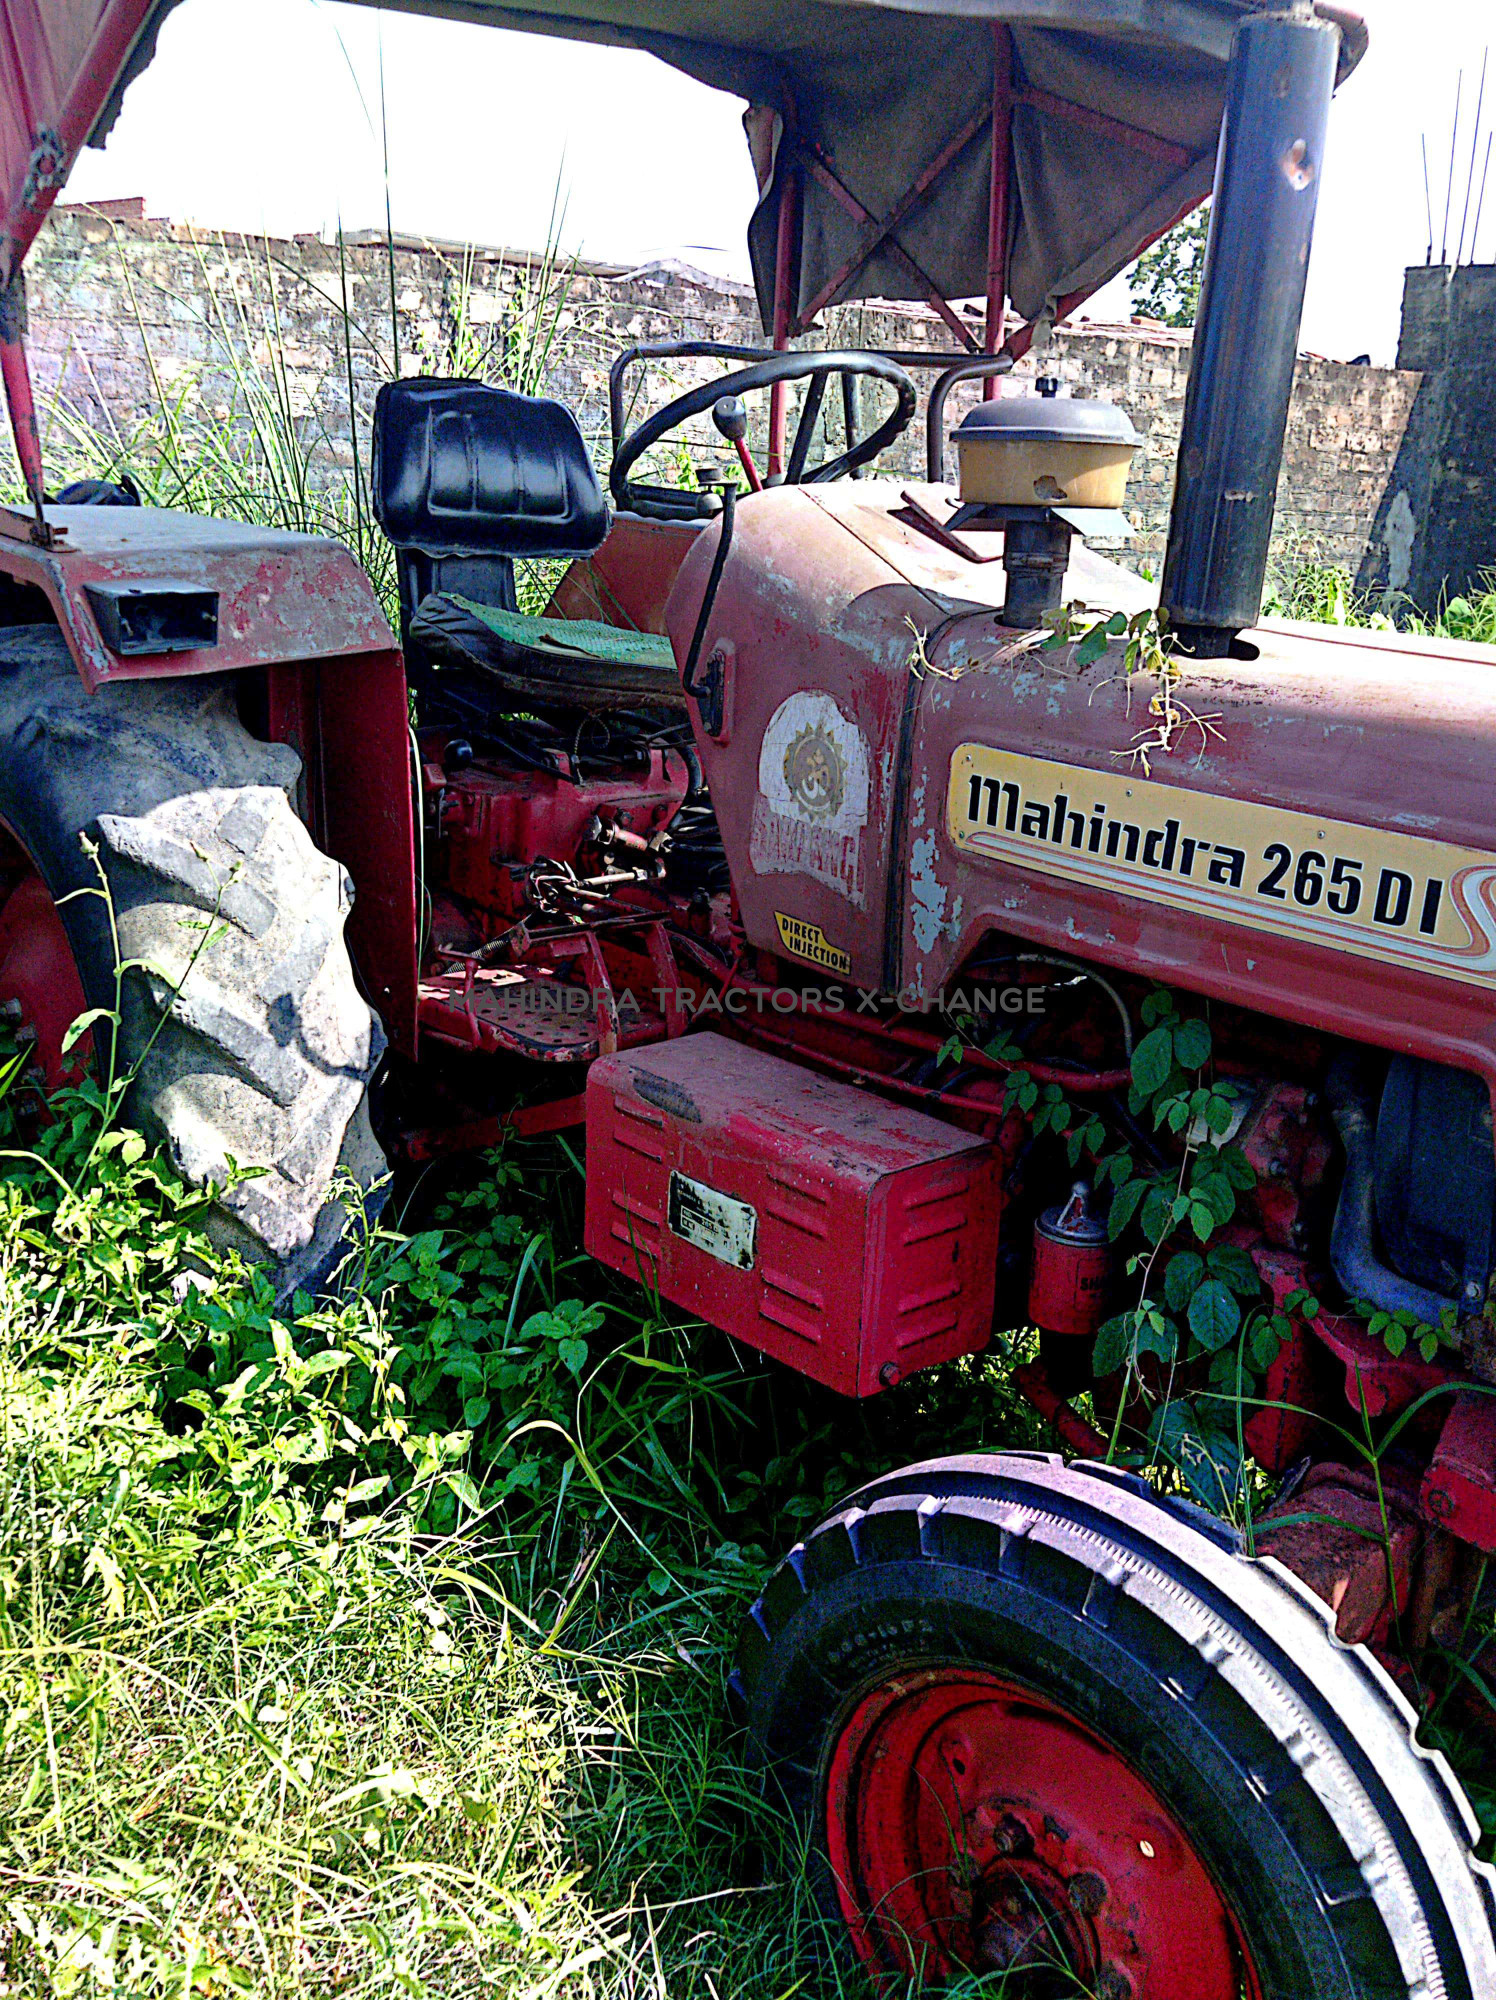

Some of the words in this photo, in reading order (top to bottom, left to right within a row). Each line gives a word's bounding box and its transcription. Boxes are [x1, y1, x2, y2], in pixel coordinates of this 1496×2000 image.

[1256, 842, 1364, 916] 265
[1373, 867, 1445, 935] DI
[782, 917, 820, 943] DIRECT
[789, 936, 847, 970] INJECTION
